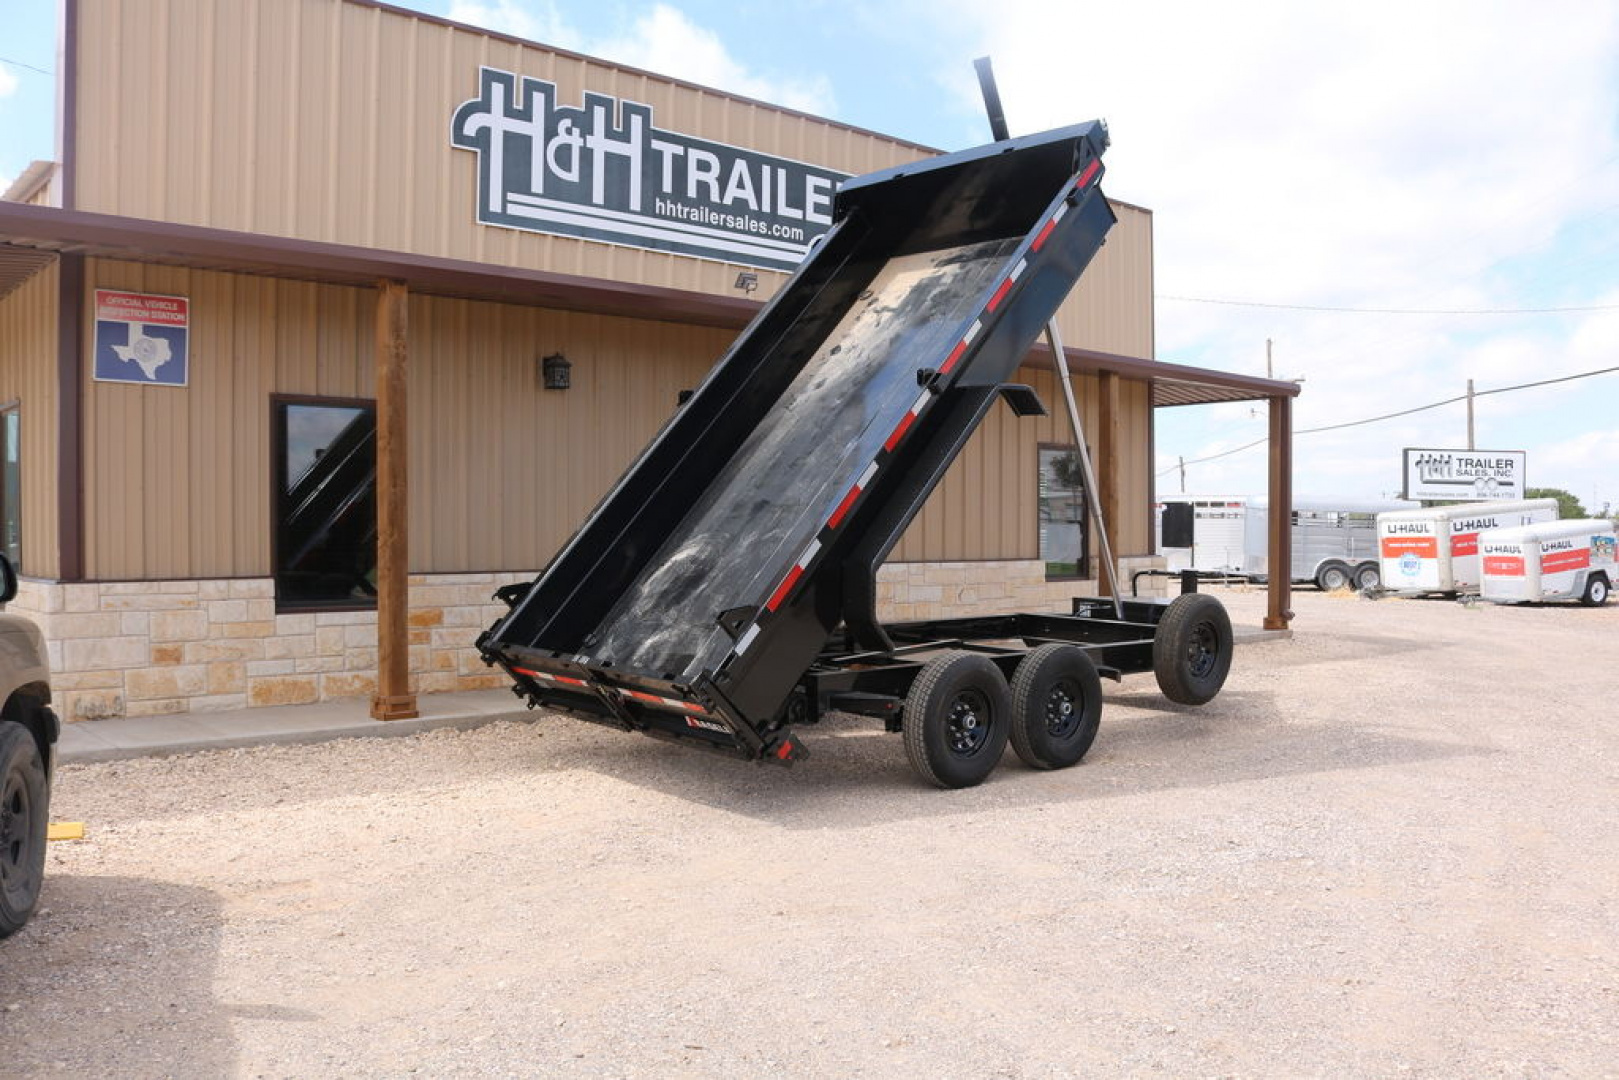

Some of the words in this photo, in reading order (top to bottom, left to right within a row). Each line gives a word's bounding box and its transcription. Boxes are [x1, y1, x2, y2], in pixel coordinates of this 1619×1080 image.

[463, 82, 643, 212] H&H
[651, 139, 843, 226] TRAILE
[655, 198, 804, 241] hhtrailersales.com
[1456, 458, 1514, 469] TRAILER
